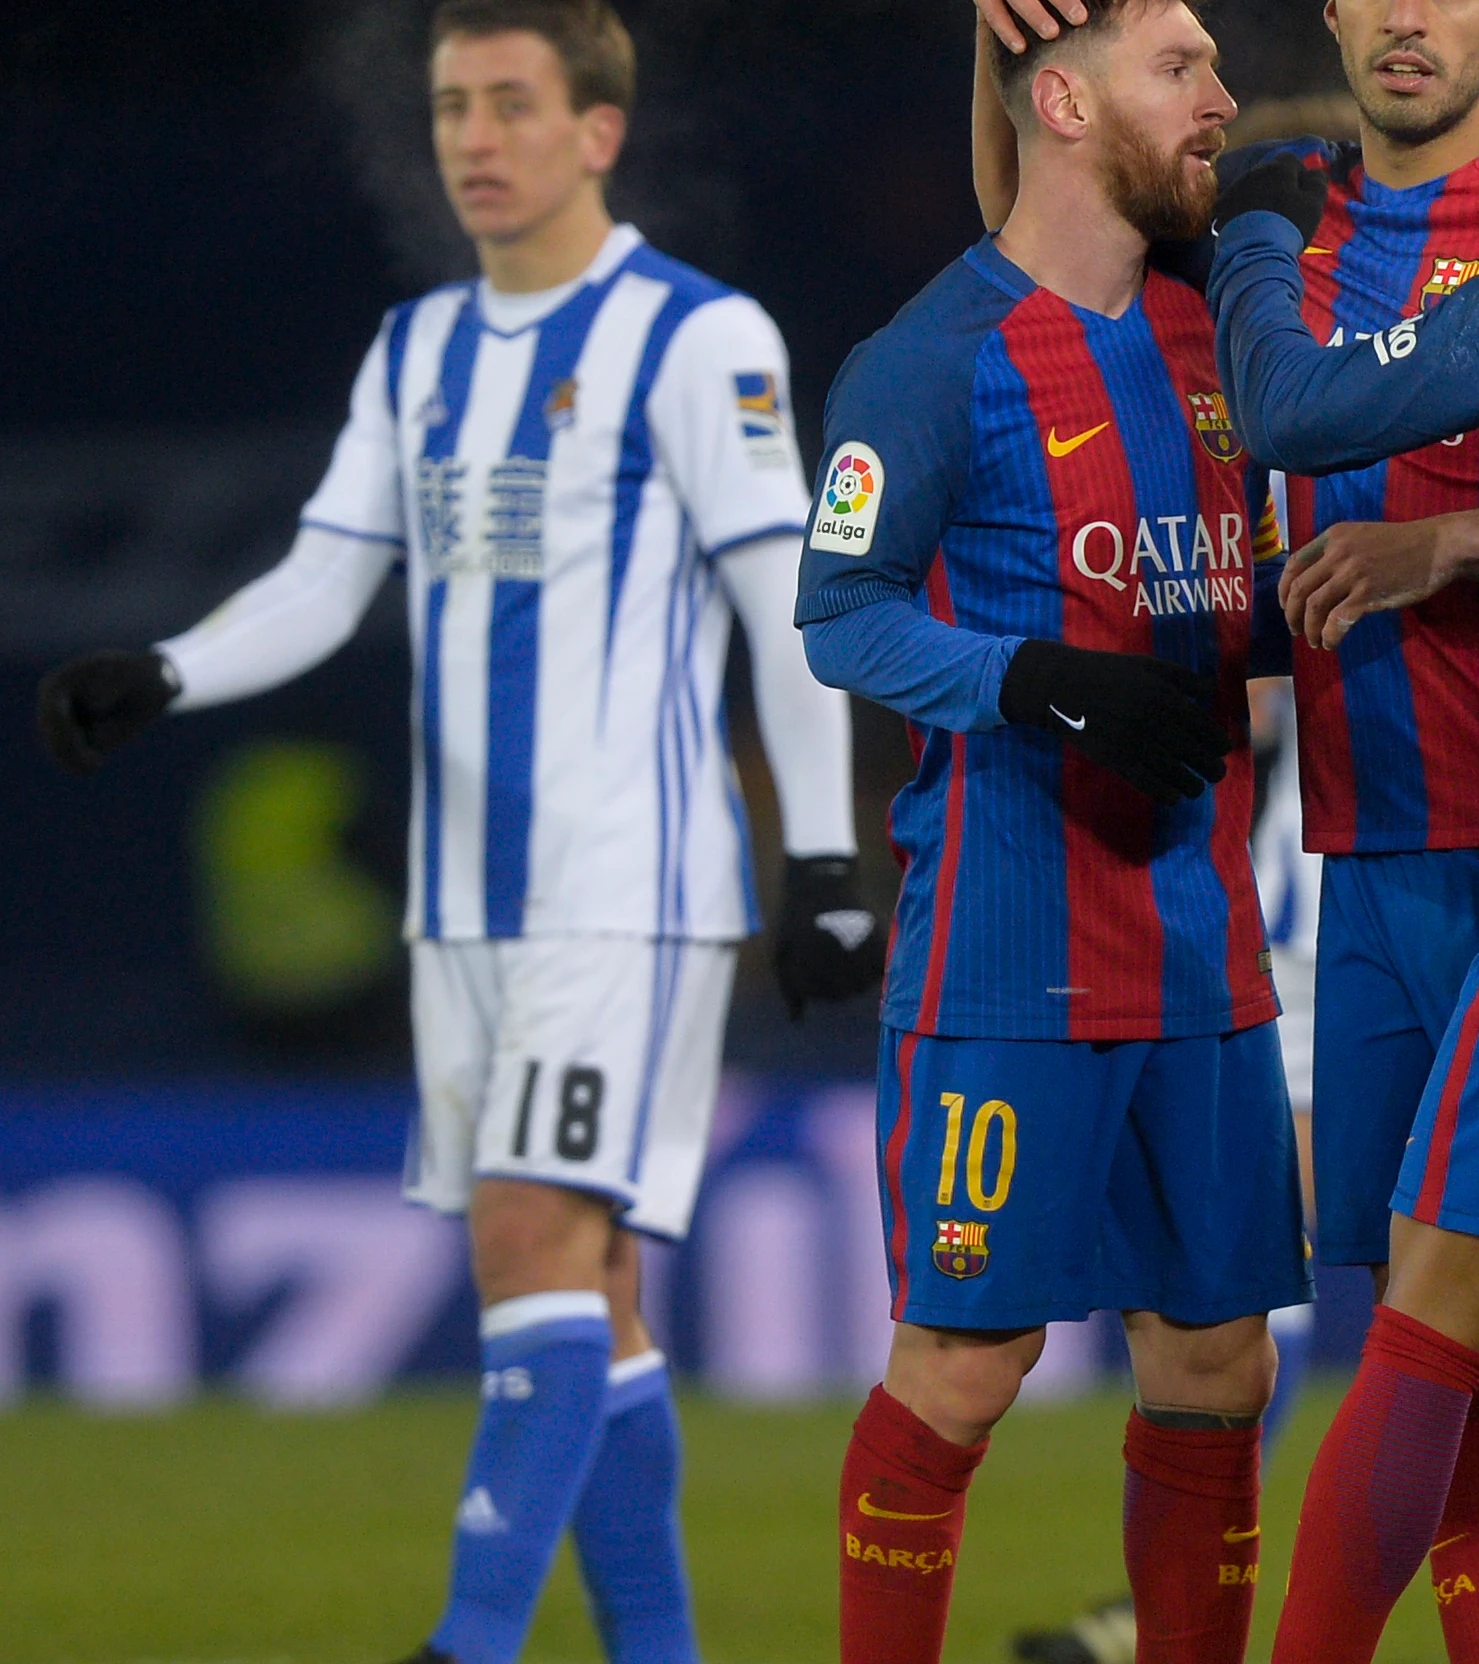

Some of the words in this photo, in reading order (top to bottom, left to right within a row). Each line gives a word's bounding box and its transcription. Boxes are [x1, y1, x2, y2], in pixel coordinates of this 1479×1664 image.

[1072, 512, 1245, 592] QATAR
[1132, 575, 1248, 618] AIRWAYS
[513, 1057, 606, 1163] 18
[937, 1091, 1018, 1213] 10
[846, 1532, 953, 1575] BARÇA
